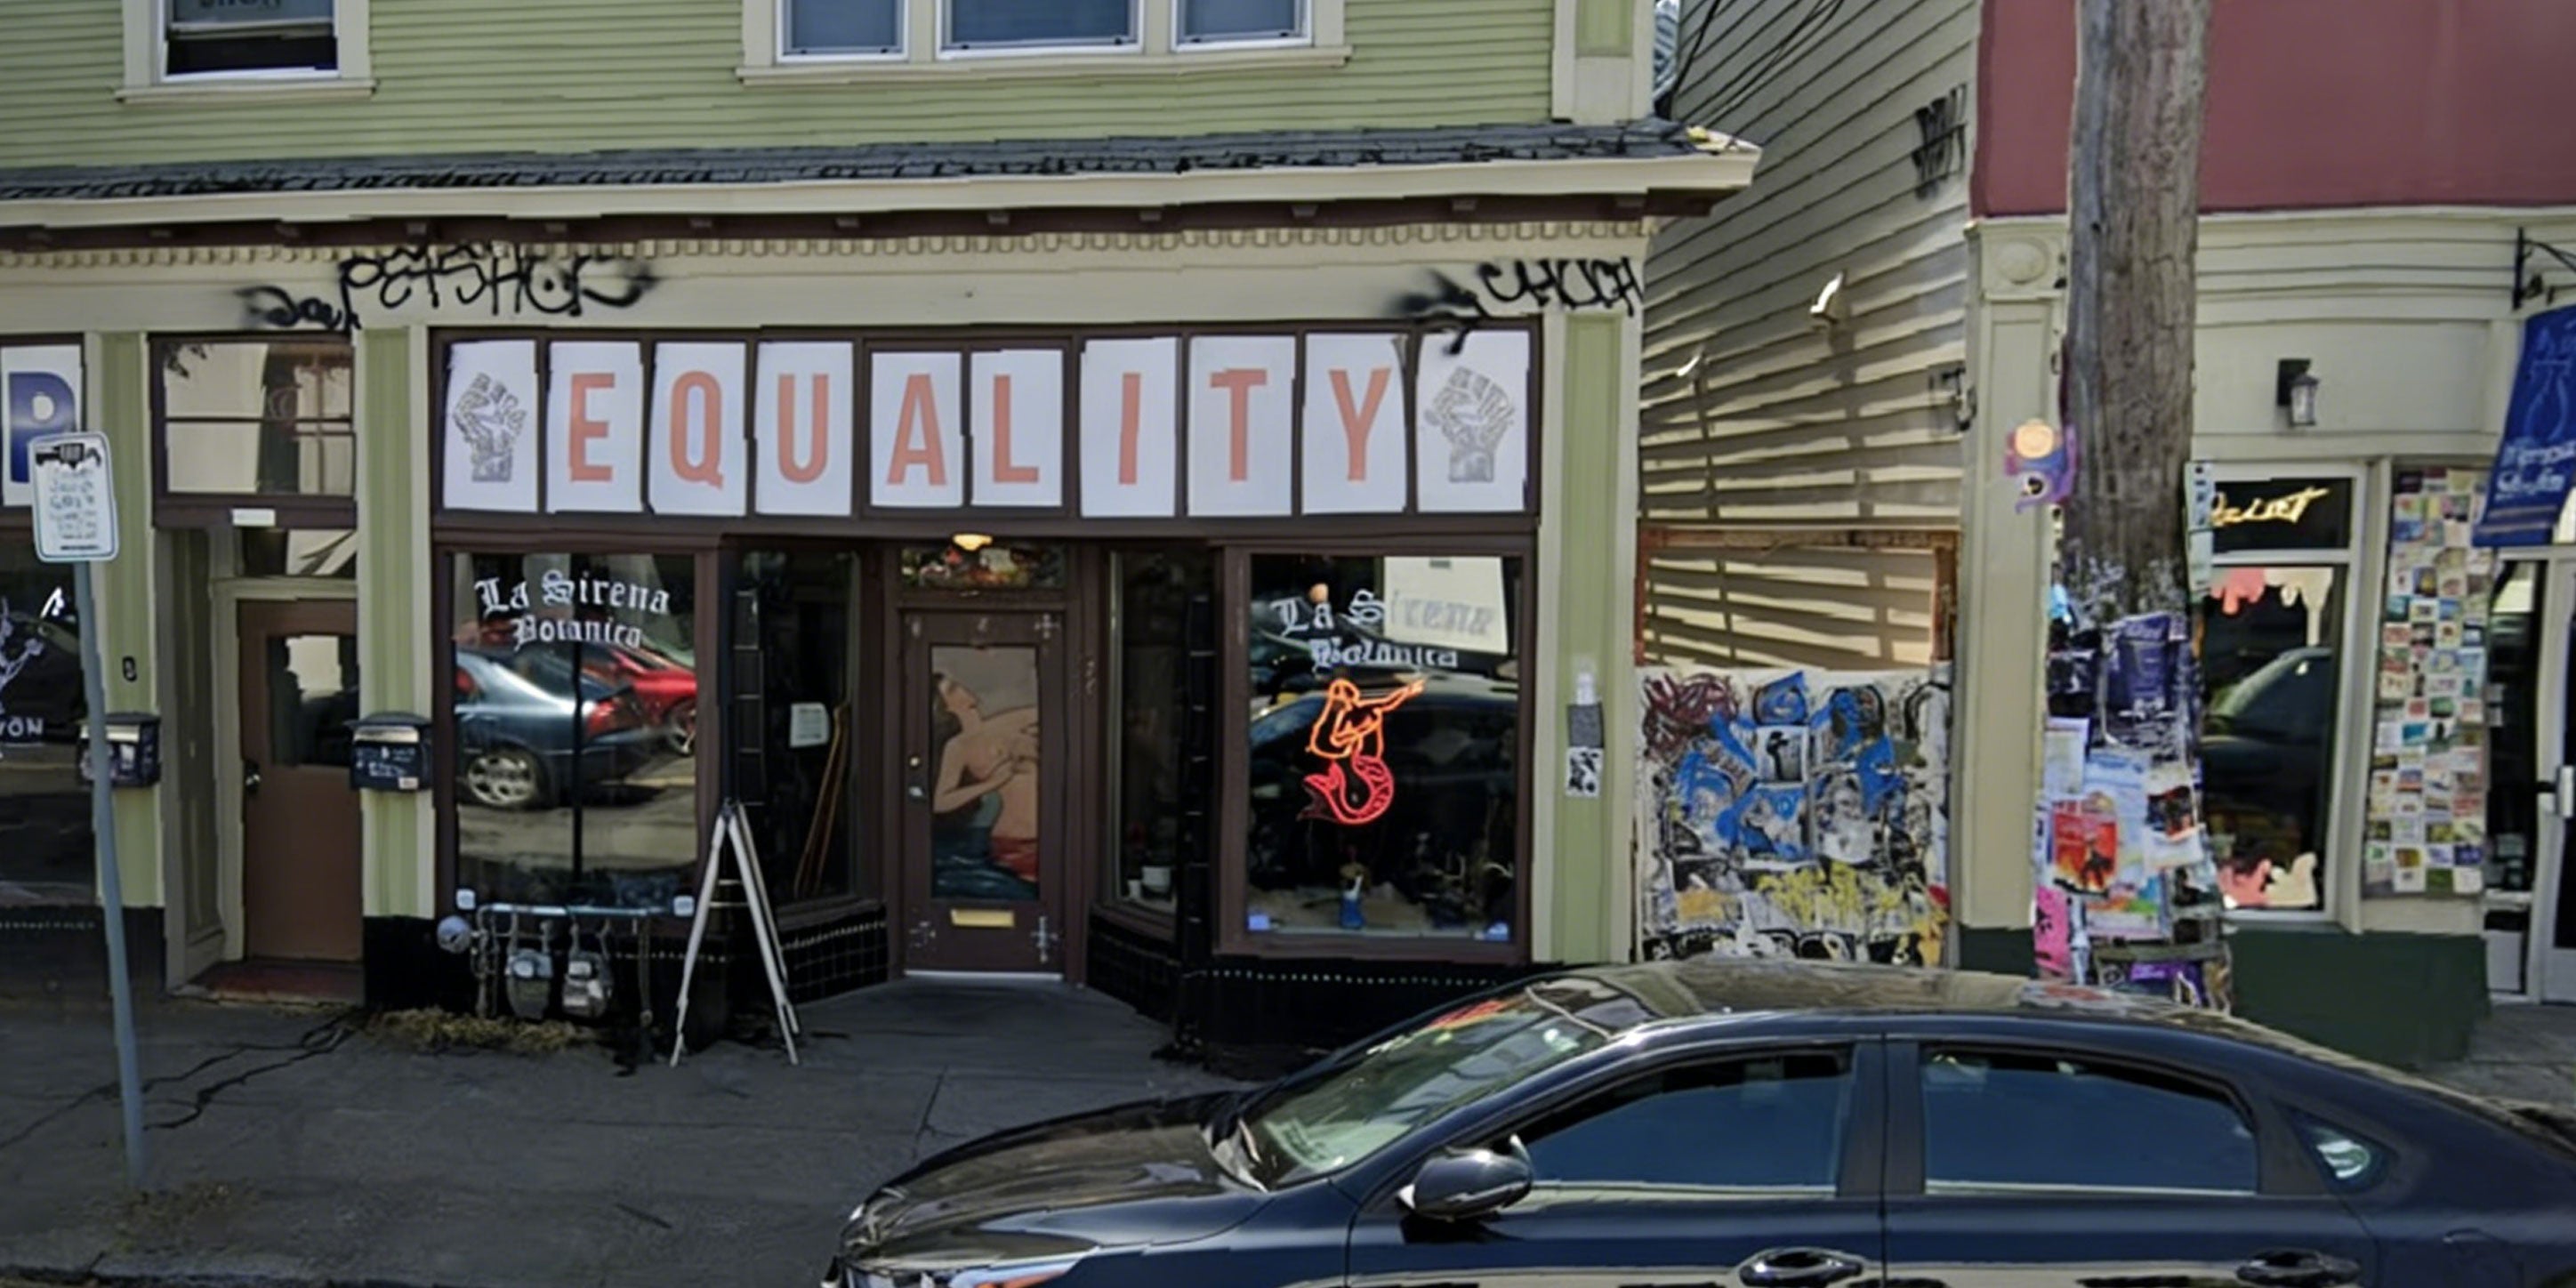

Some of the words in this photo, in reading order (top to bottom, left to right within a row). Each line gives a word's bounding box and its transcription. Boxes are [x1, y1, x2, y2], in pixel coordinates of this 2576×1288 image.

[568, 367, 1392, 490] EQUALITY
[474, 576, 530, 618] La
[541, 569, 670, 616] Sirena
[1269, 596, 1334, 637] La
[1348, 589, 1498, 636] Sirena
[511, 615, 643, 652] Botanica
[1308, 637, 1459, 672] Botanica
